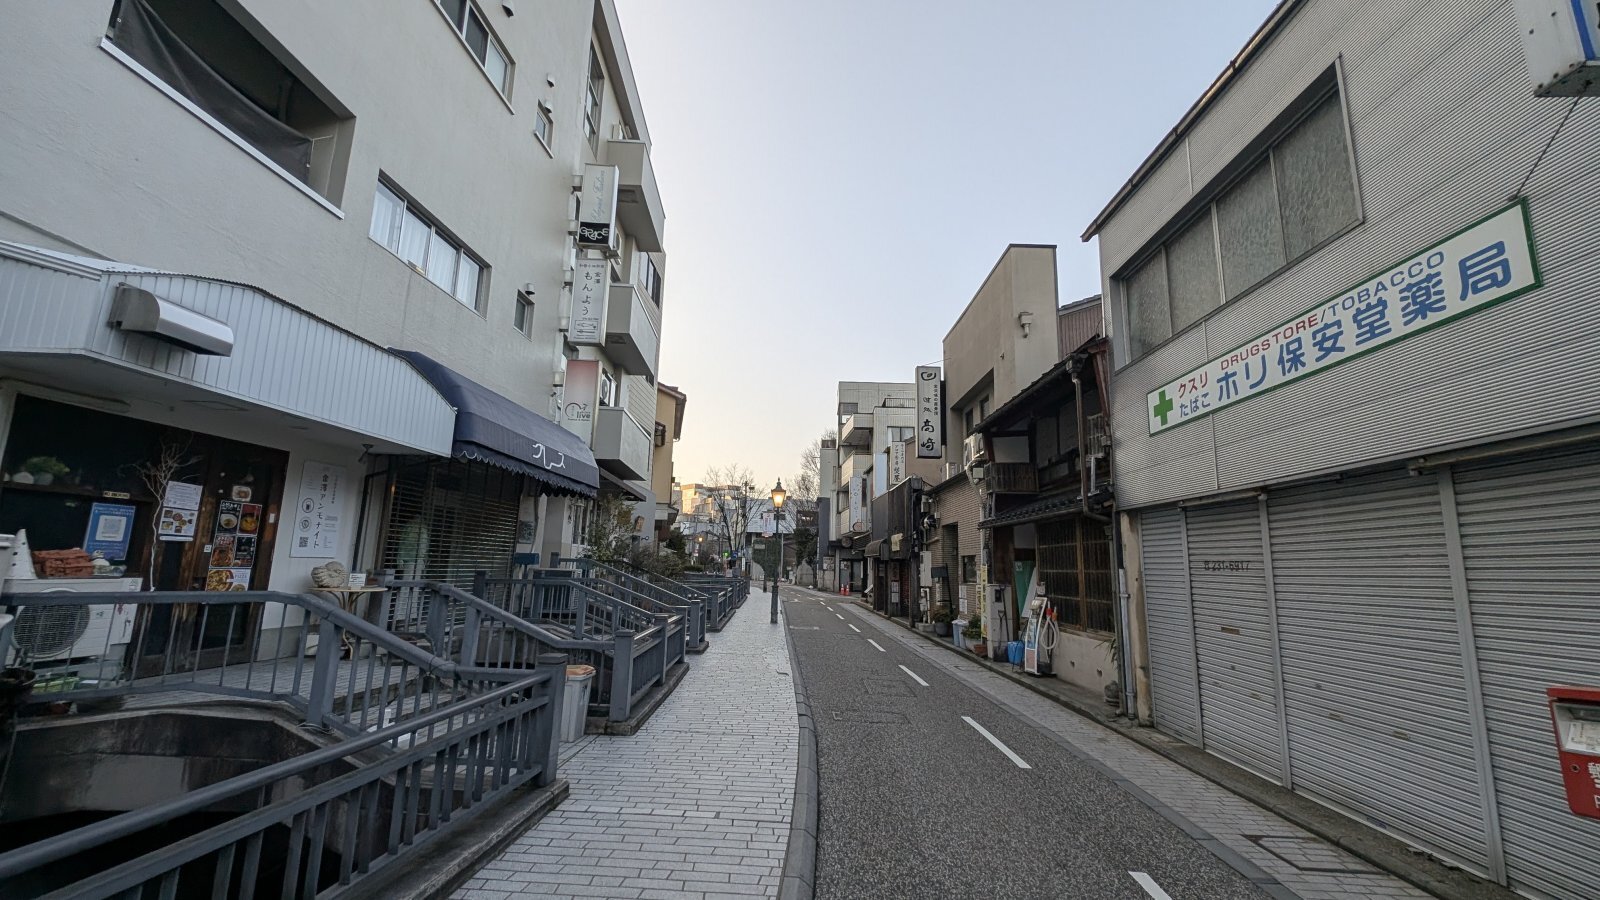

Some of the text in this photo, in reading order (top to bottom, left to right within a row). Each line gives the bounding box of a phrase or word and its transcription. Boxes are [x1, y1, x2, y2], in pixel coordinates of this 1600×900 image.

[579, 226, 609, 241] GRACE
[1216, 240, 1513, 402] ホリ保安堂薬局
[1177, 371, 1209, 399] クスリ
[1178, 392, 1212, 419] たばこ
